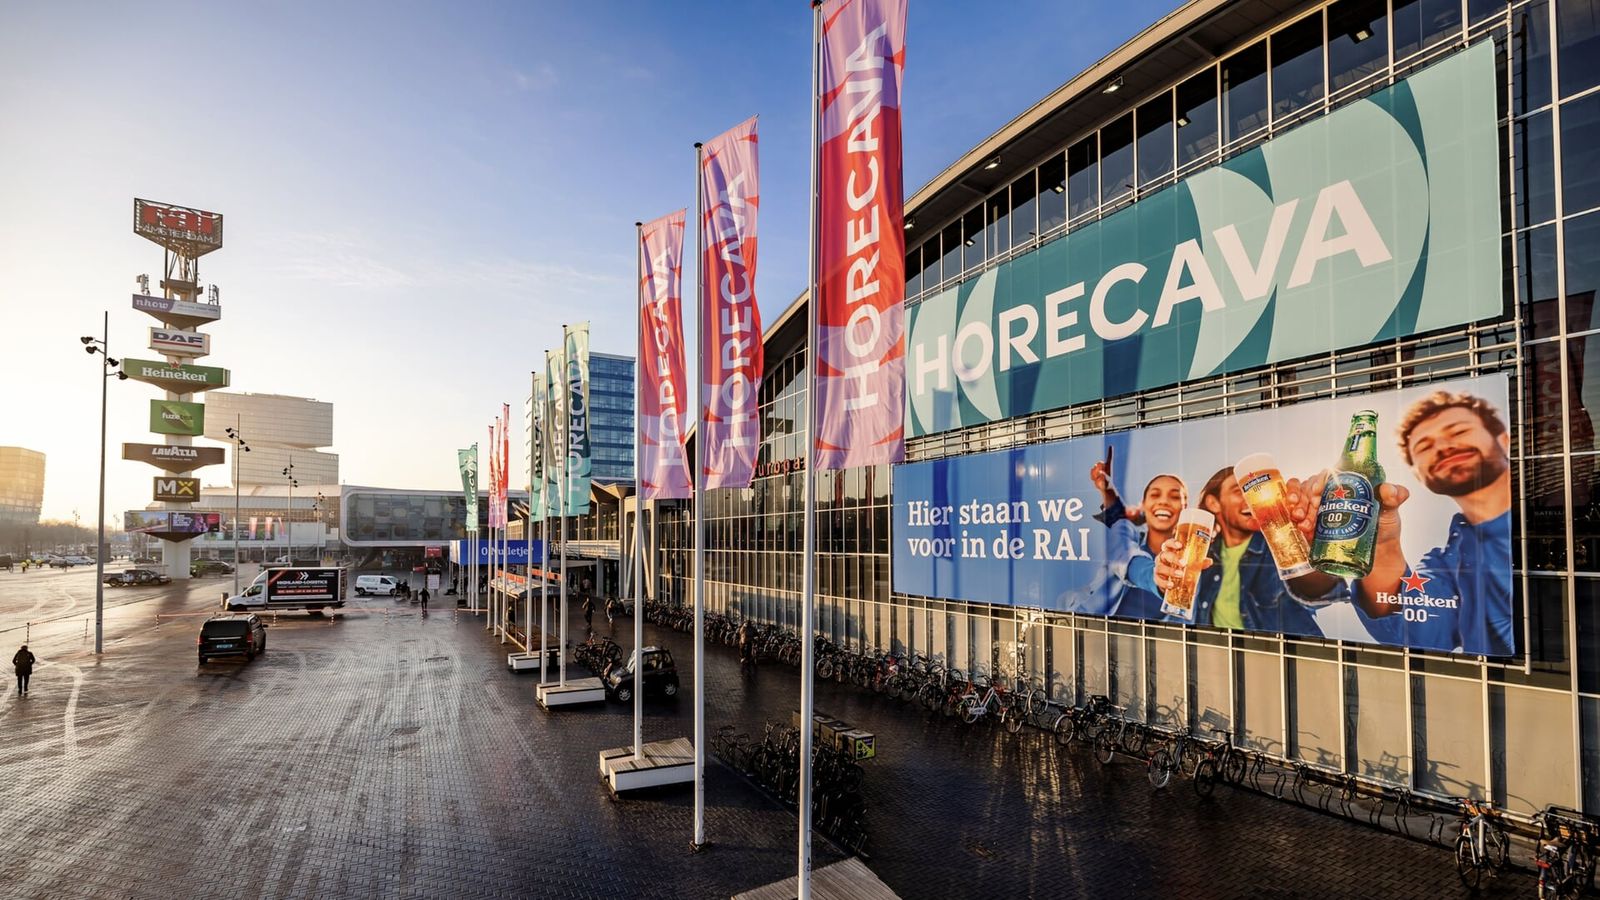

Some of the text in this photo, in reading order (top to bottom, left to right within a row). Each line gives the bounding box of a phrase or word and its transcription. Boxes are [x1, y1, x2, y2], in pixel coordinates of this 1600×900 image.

[844, 21, 887, 411] HORECAVA
[915, 179, 1393, 396] HORECAVA
[720, 171, 751, 449] HORECAVA
[153, 332, 202, 343] DAF
[142, 367, 206, 382] Heineken
[152, 446, 198, 457] LAVAZZA
[157, 480, 194, 495] MX
[908, 497, 1083, 526] Hier staan we
[908, 528, 1090, 561] voor in de RAI
[1376, 592, 1457, 609] Heineken
[1404, 608, 1428, 622] 0.0
